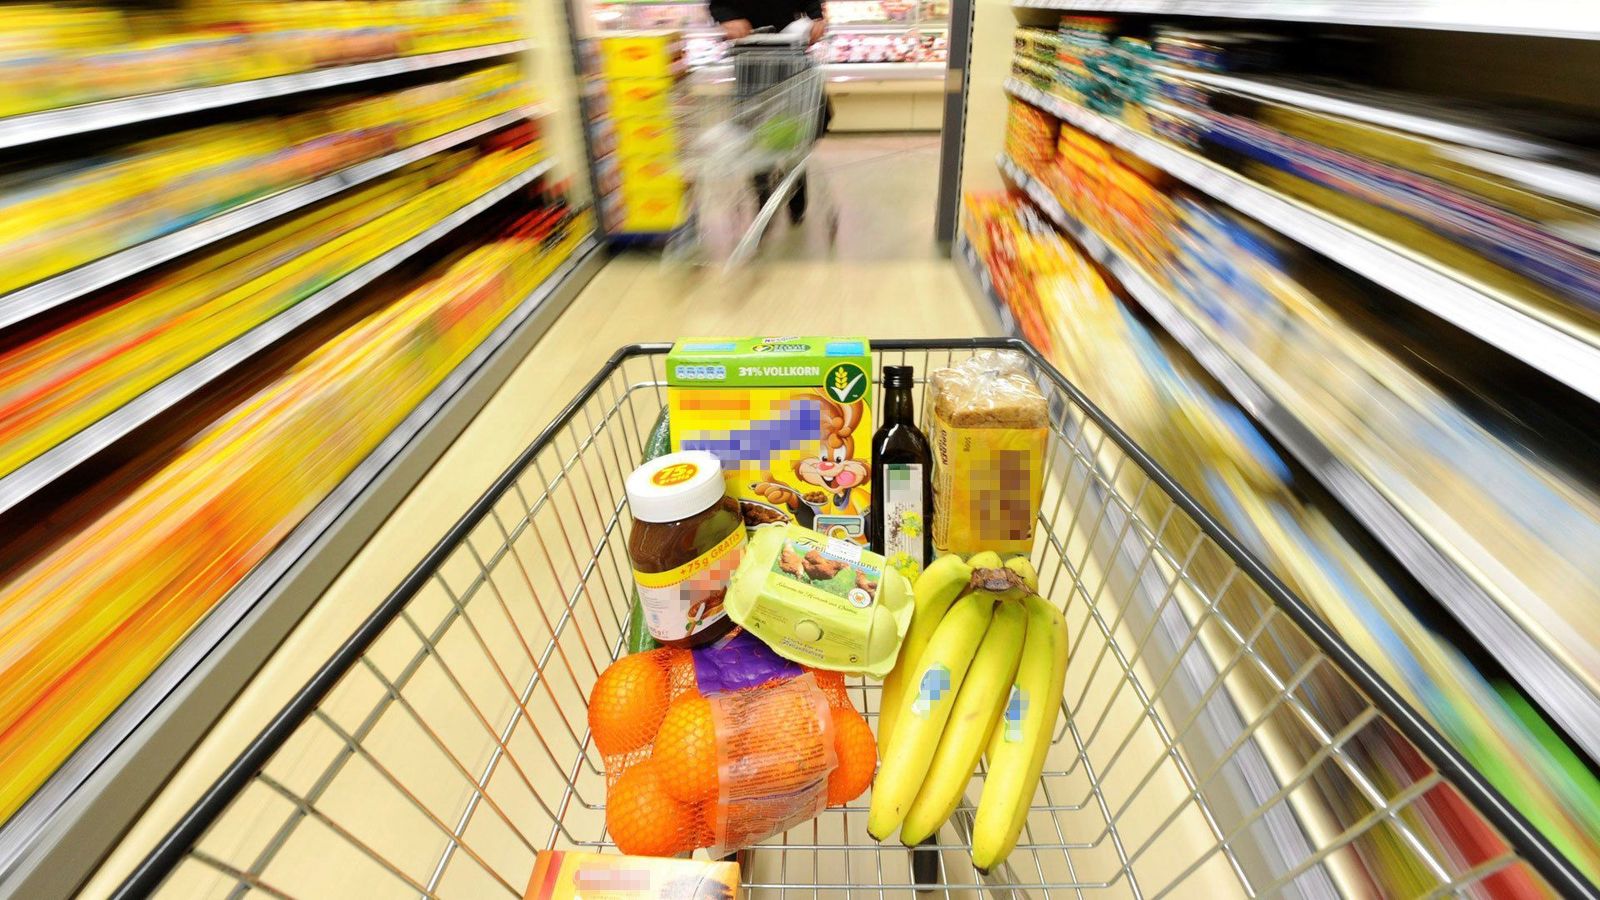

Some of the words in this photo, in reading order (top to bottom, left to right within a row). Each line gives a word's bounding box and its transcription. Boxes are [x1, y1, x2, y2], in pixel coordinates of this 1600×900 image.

[738, 366, 762, 377] 31%
[763, 366, 820, 377] VOLLKORN
[710, 532, 741, 559] GRATIS
